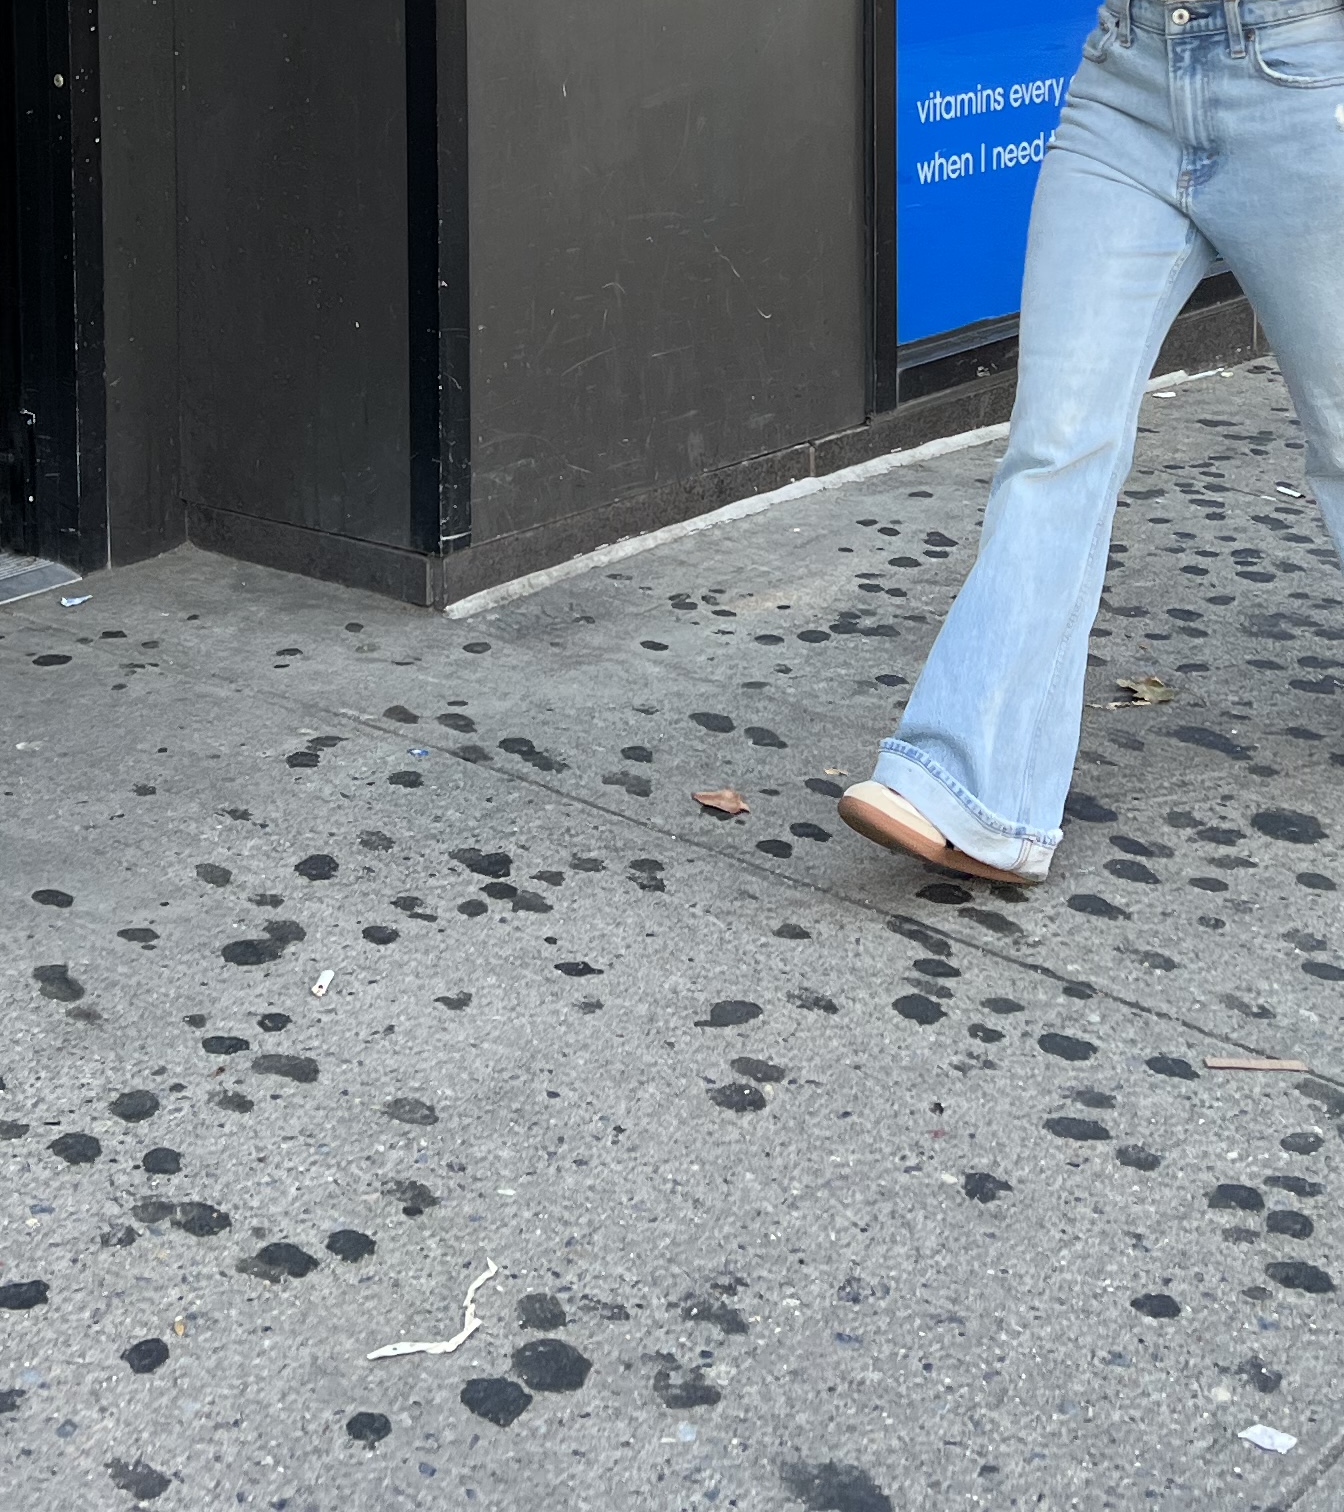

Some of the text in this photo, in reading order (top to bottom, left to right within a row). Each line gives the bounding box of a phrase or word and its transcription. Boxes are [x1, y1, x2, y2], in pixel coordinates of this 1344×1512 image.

[916, 76, 1064, 124] vitamins every
[916, 151, 974, 185] when
[979, 142, 986, 173] I
[992, 131, 1044, 170] need
